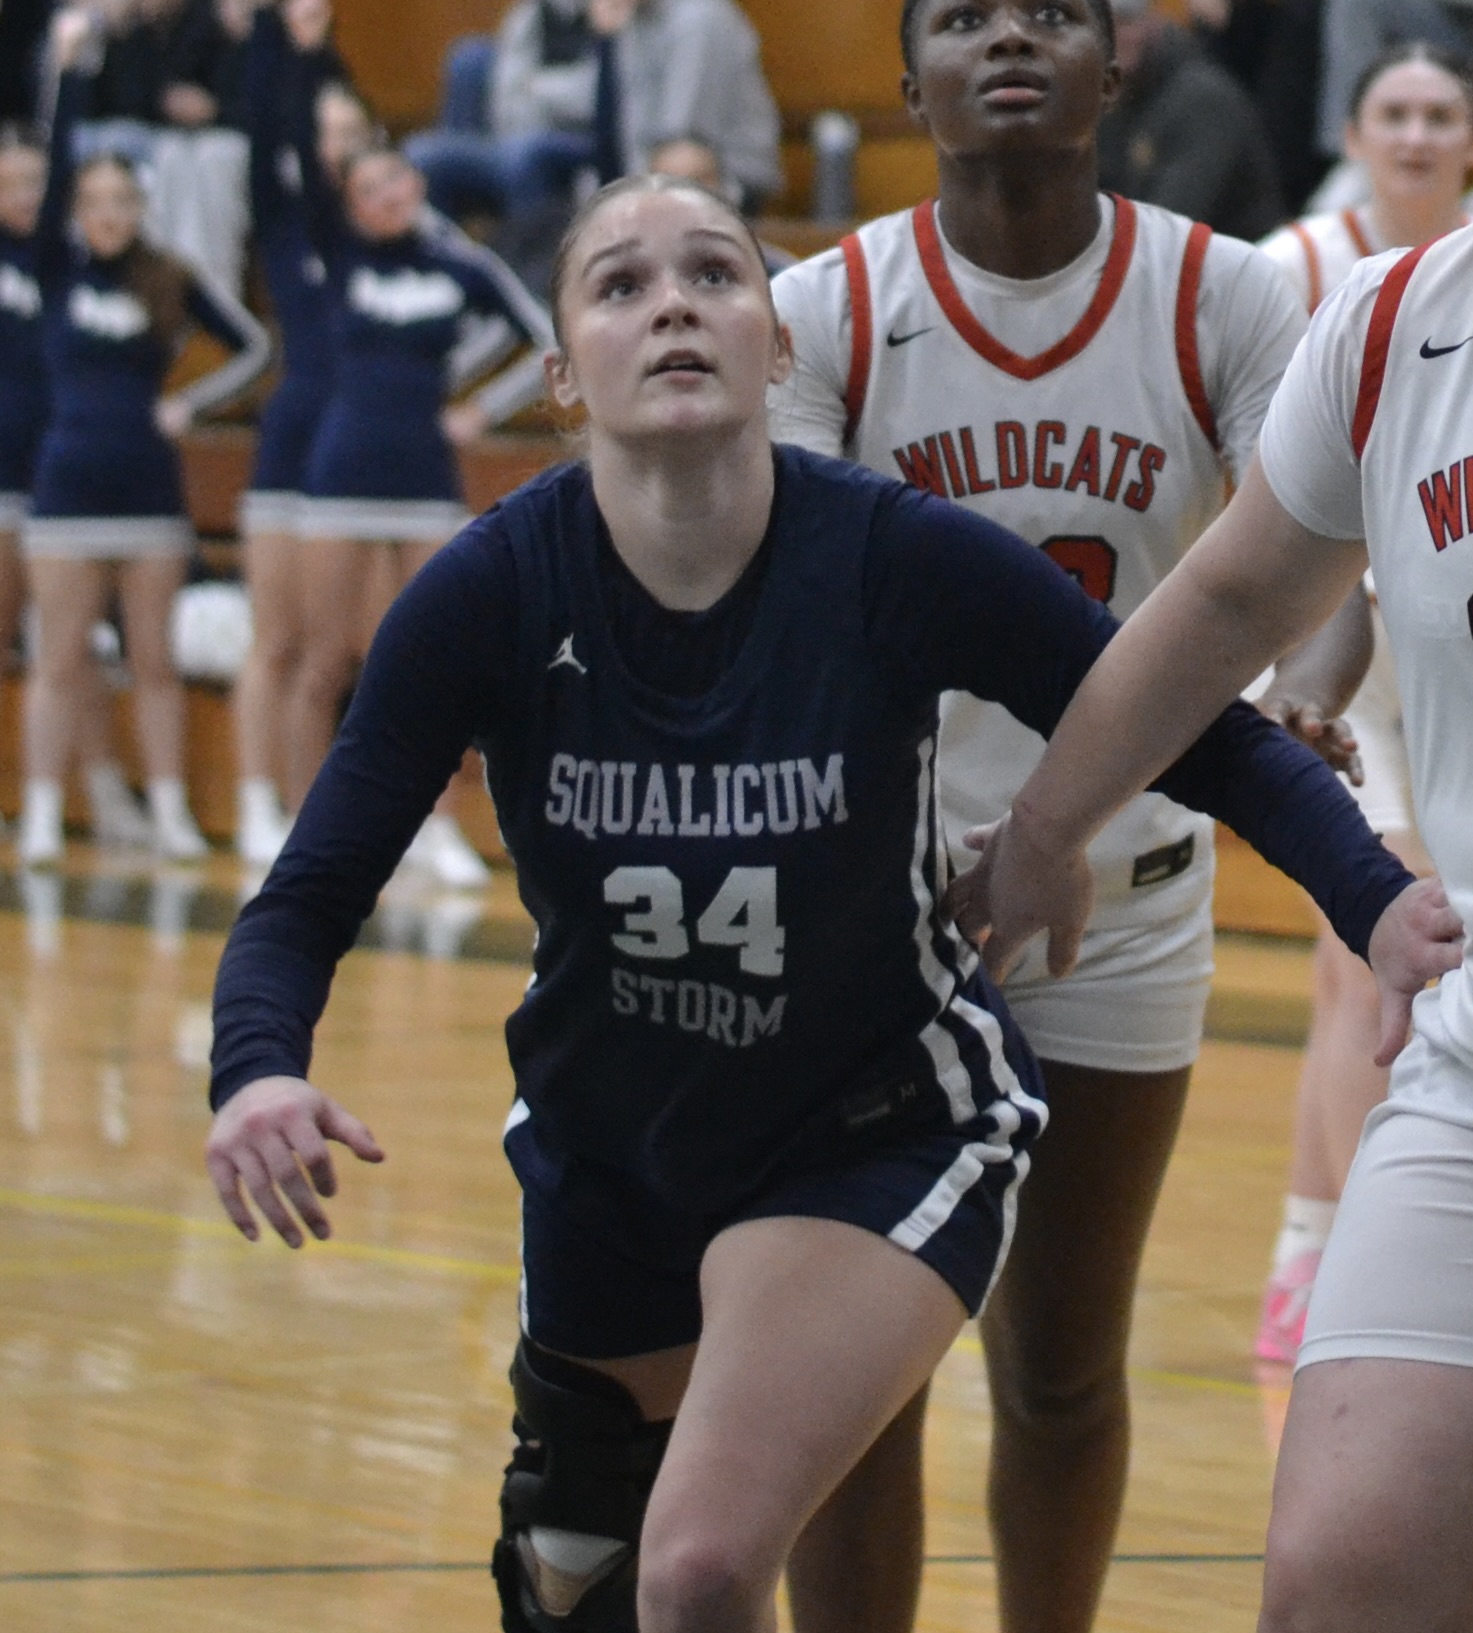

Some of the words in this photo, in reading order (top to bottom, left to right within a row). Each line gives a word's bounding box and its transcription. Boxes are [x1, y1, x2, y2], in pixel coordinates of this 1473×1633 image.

[893, 420, 1167, 512] WILDCATS
[545, 752, 848, 840] SQUALICUM
[604, 866, 785, 976] 34
[611, 966, 788, 1047] STORM
